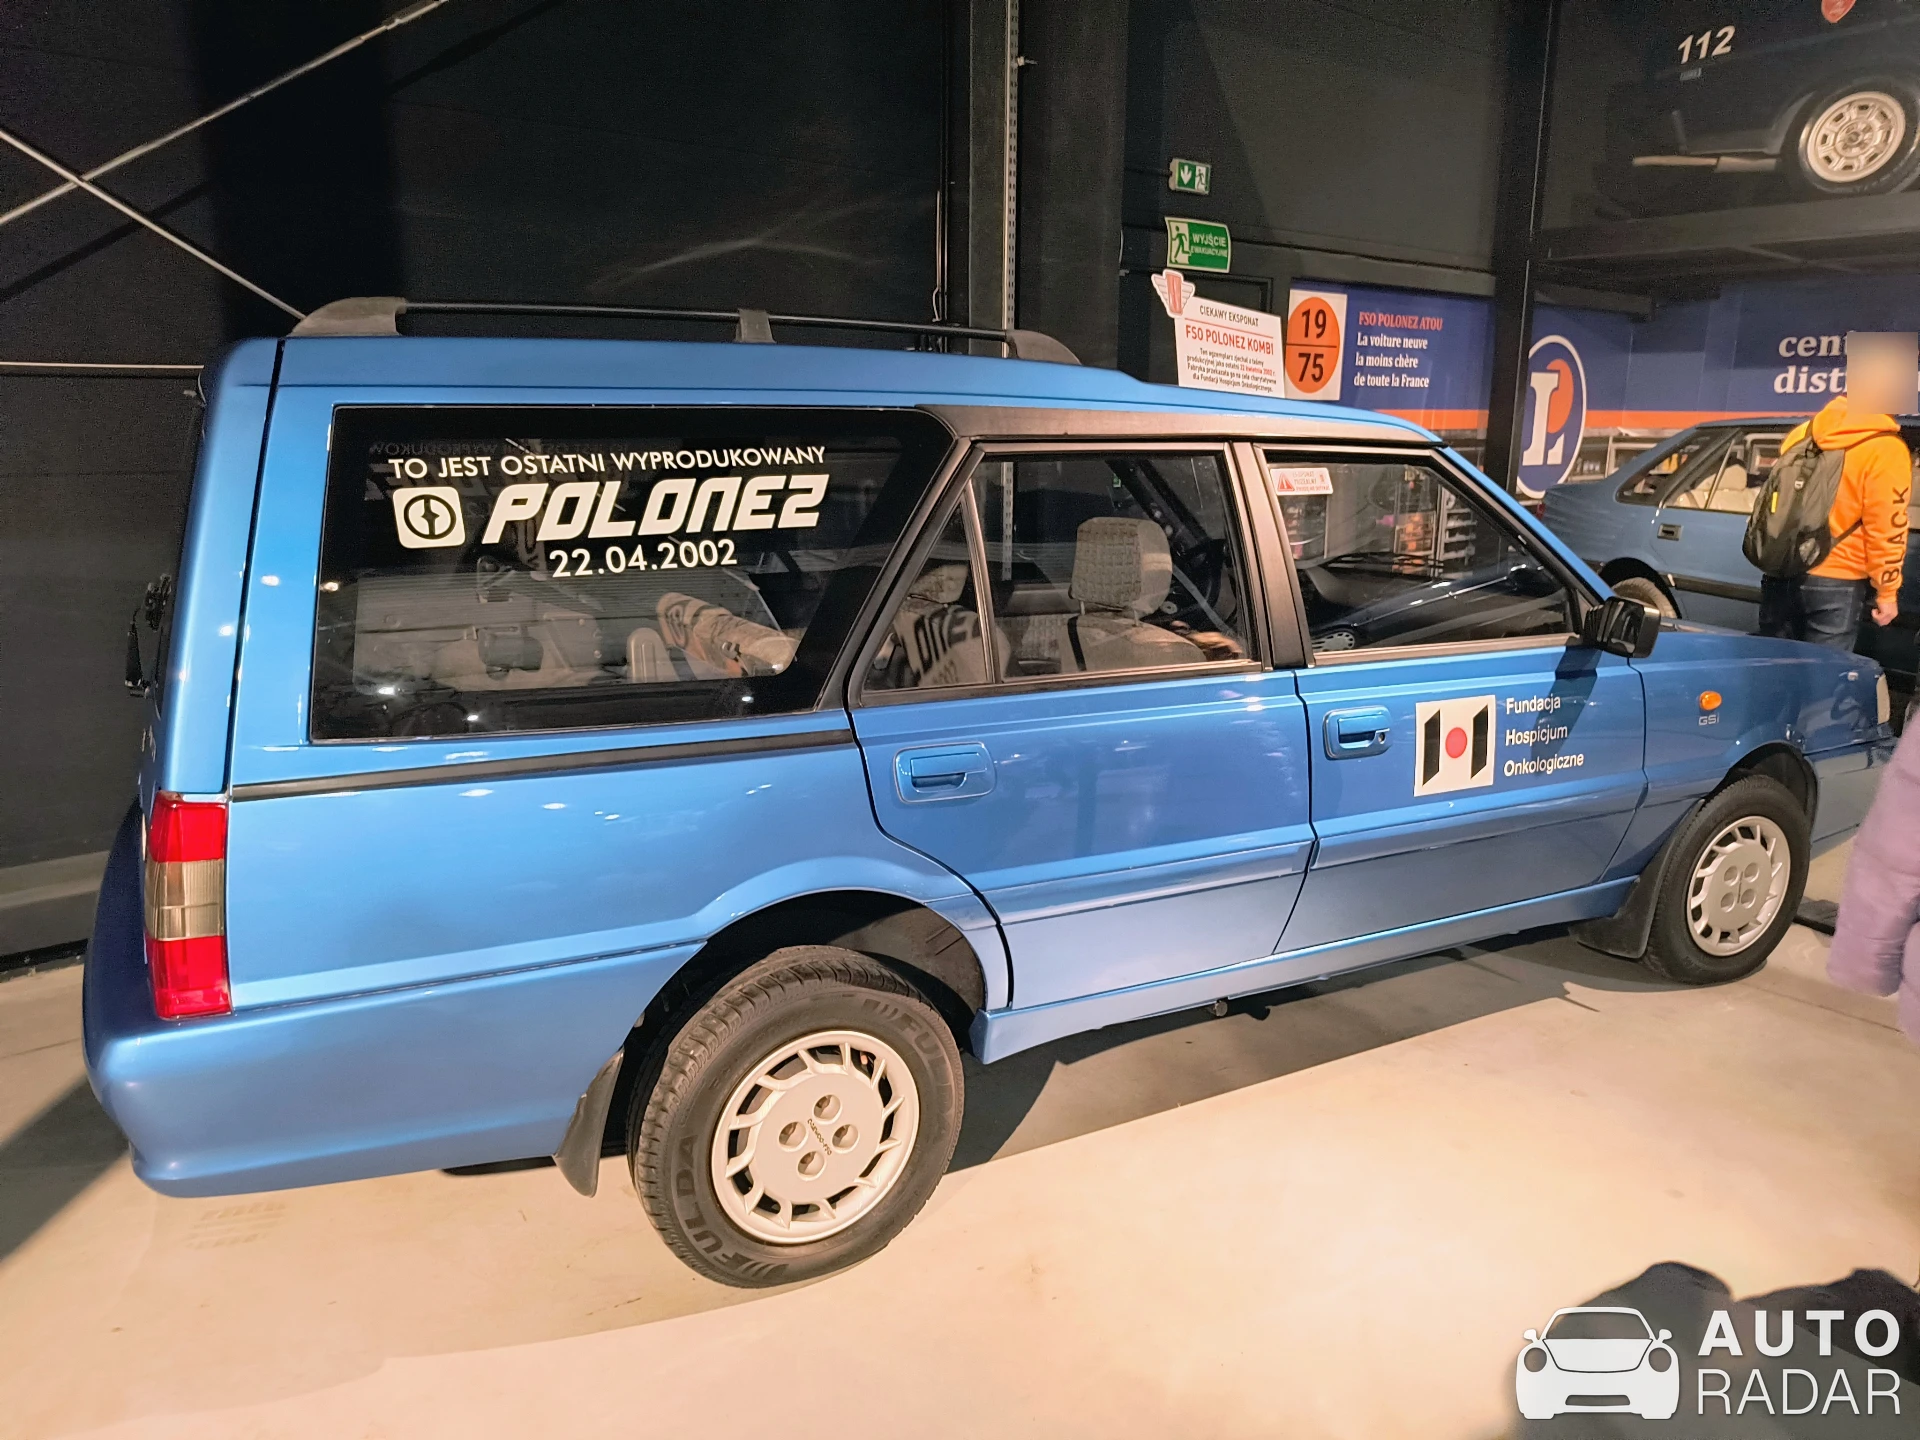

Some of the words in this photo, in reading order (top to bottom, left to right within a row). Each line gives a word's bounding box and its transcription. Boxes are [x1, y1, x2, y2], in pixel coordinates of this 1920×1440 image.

[1678, 25, 1736, 65] 112
[1192, 232, 1227, 248] WYJŚCIE
[1200, 305, 1227, 320] CIEKAWY
[1229, 314, 1259, 327] EKSPONAT
[1301, 308, 1327, 339] 19
[1359, 311, 1376, 326] FSO
[1377, 313, 1418, 330] POLONEZ
[1420, 316, 1443, 331] ATOU
[1185, 324, 1203, 341] FSO
[1205, 329, 1246, 350] POLONEZ
[1248, 337, 1274, 355] KOMBI
[1357, 332, 1368, 346] La
[1369, 333, 1401, 348] voiture
[1403, 337, 1428, 350] neuve
[1298, 352, 1325, 383] 75
[1355, 351, 1364, 366] la
[1365, 353, 1393, 367] moins
[1394, 353, 1418, 368] chère
[1354, 372, 1365, 387] de
[1366, 374, 1390, 387] toute
[1391, 373, 1400, 387] la
[1401, 374, 1430, 388] France
[388, 457, 428, 480] TO
[438, 455, 492, 478] JEST
[501, 453, 606, 475] OSTATNI
[610, 446, 826, 471] WYPRODUKOWANY
[481, 473, 830, 545] POLONEZ
[1881, 486, 1909, 584] BLACK
[549, 539, 737, 578] 22.04.2002
[1506, 693, 1561, 715] Fundacja
[1505, 724, 1568, 746] Hospicjum
[1503, 751, 1584, 777] Onkologiczne
[676, 1134, 753, 1269] FULDA
